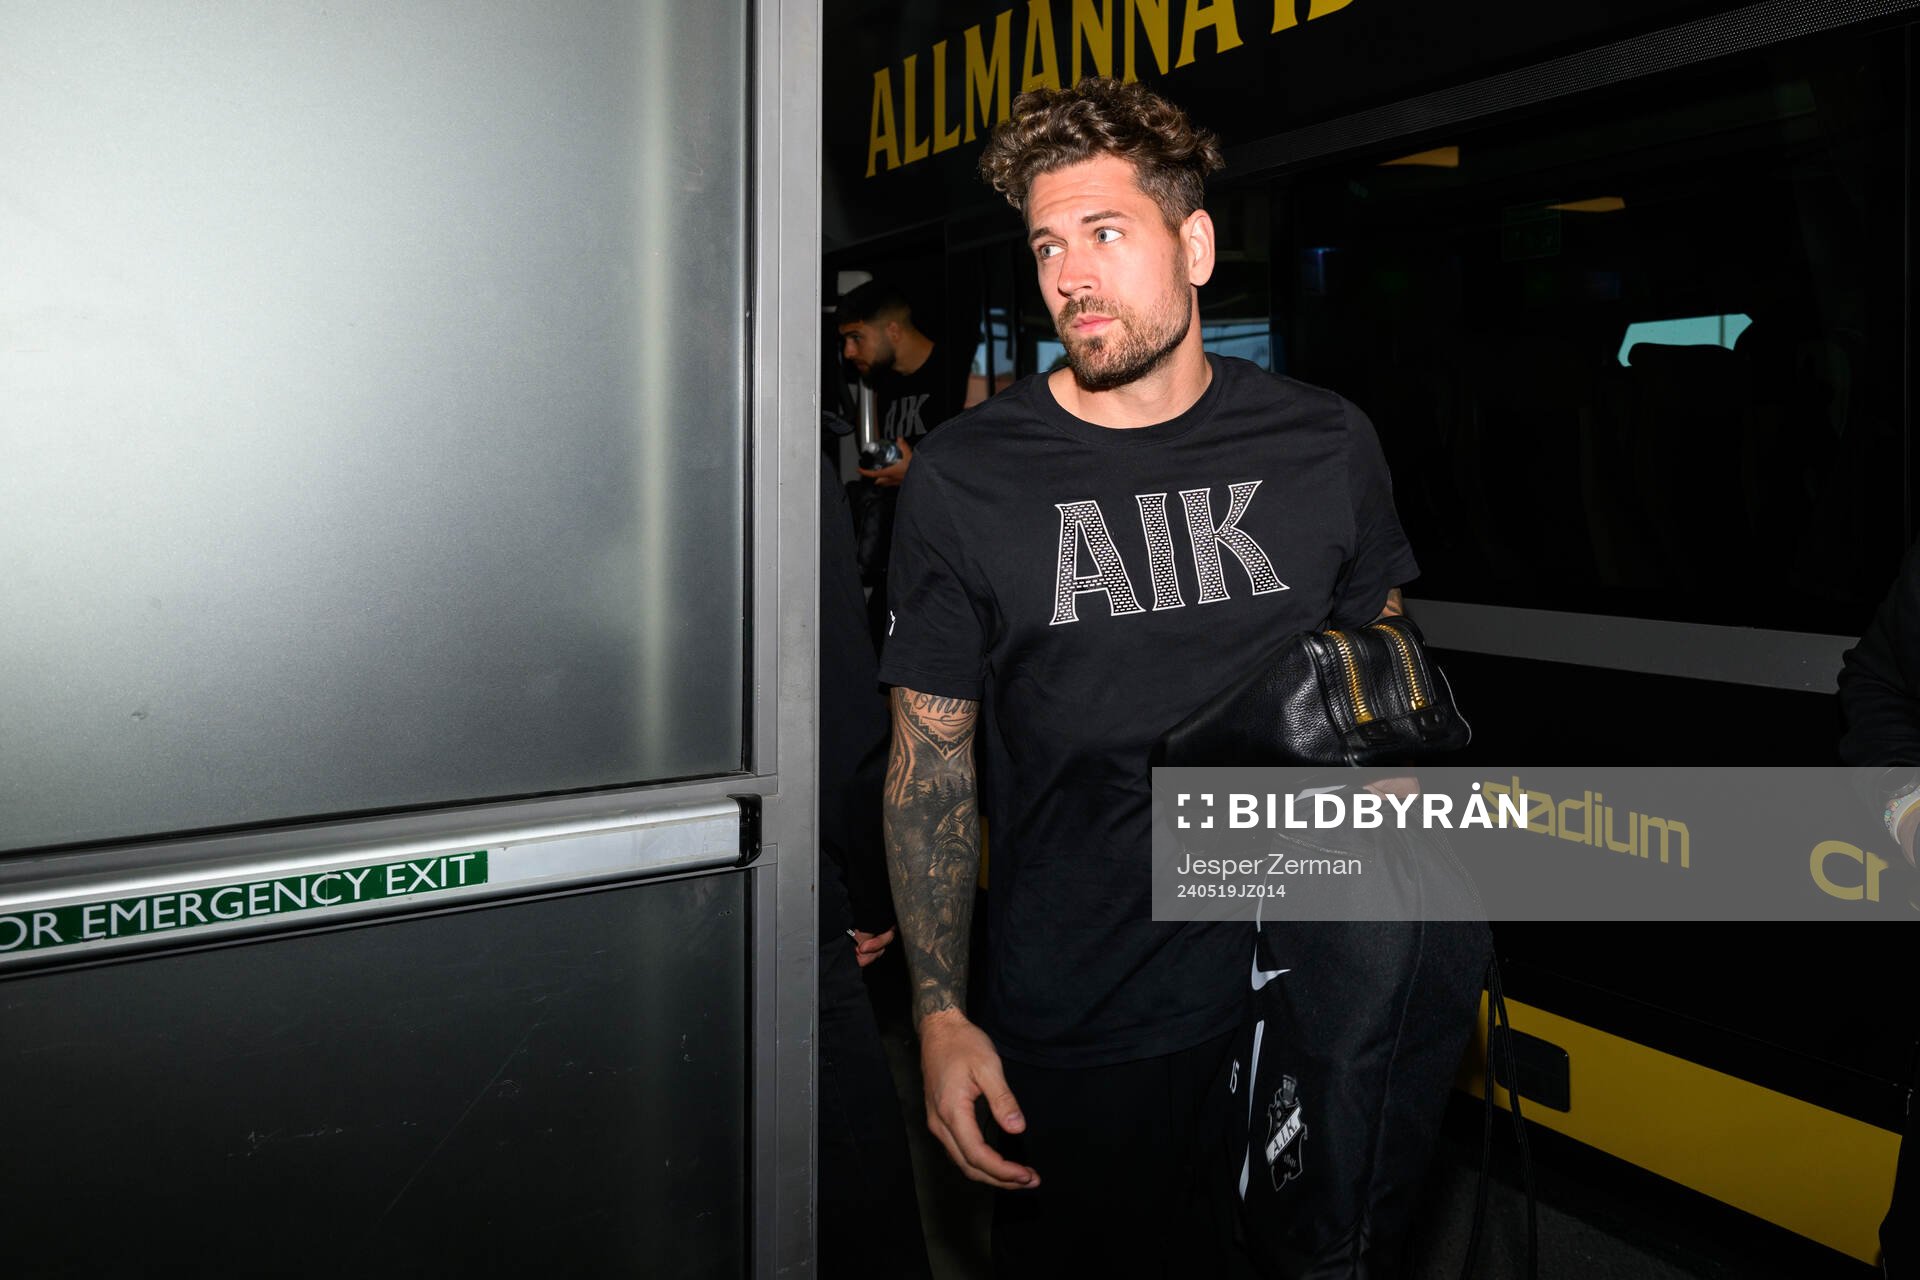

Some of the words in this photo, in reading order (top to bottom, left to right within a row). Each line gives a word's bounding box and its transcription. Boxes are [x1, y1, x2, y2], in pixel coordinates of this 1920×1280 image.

[1049, 480, 1290, 625] AIK
[82, 868, 371, 940] EMERGENCY
[386, 854, 476, 896] EXIT
